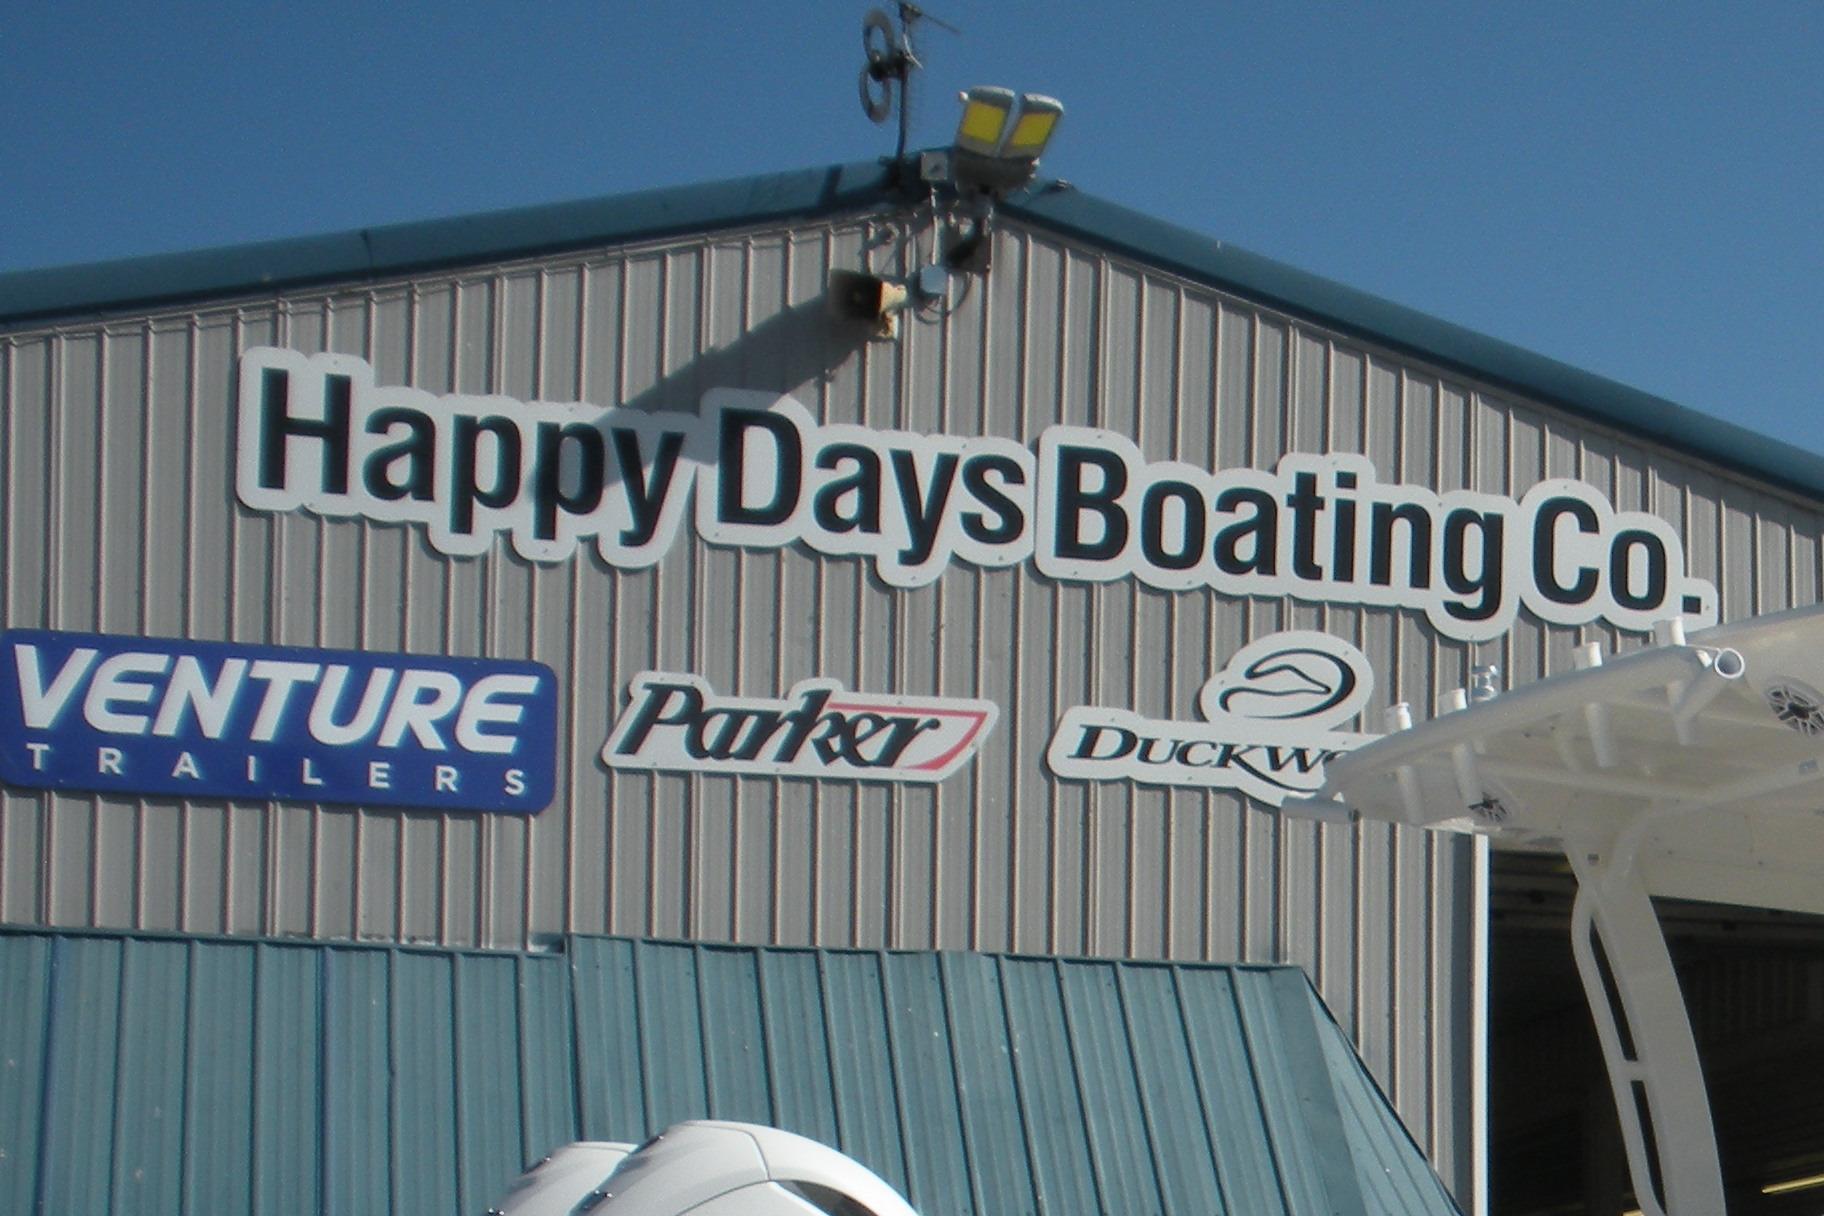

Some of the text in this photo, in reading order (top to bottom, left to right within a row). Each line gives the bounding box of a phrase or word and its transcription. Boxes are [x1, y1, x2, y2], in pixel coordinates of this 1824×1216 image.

[258, 367, 1703, 621] Happy Days Boating Co.
[14, 643, 540, 754] VENTURE
[615, 682, 941, 768] Parker
[26, 743, 527, 797] TRAILERS
